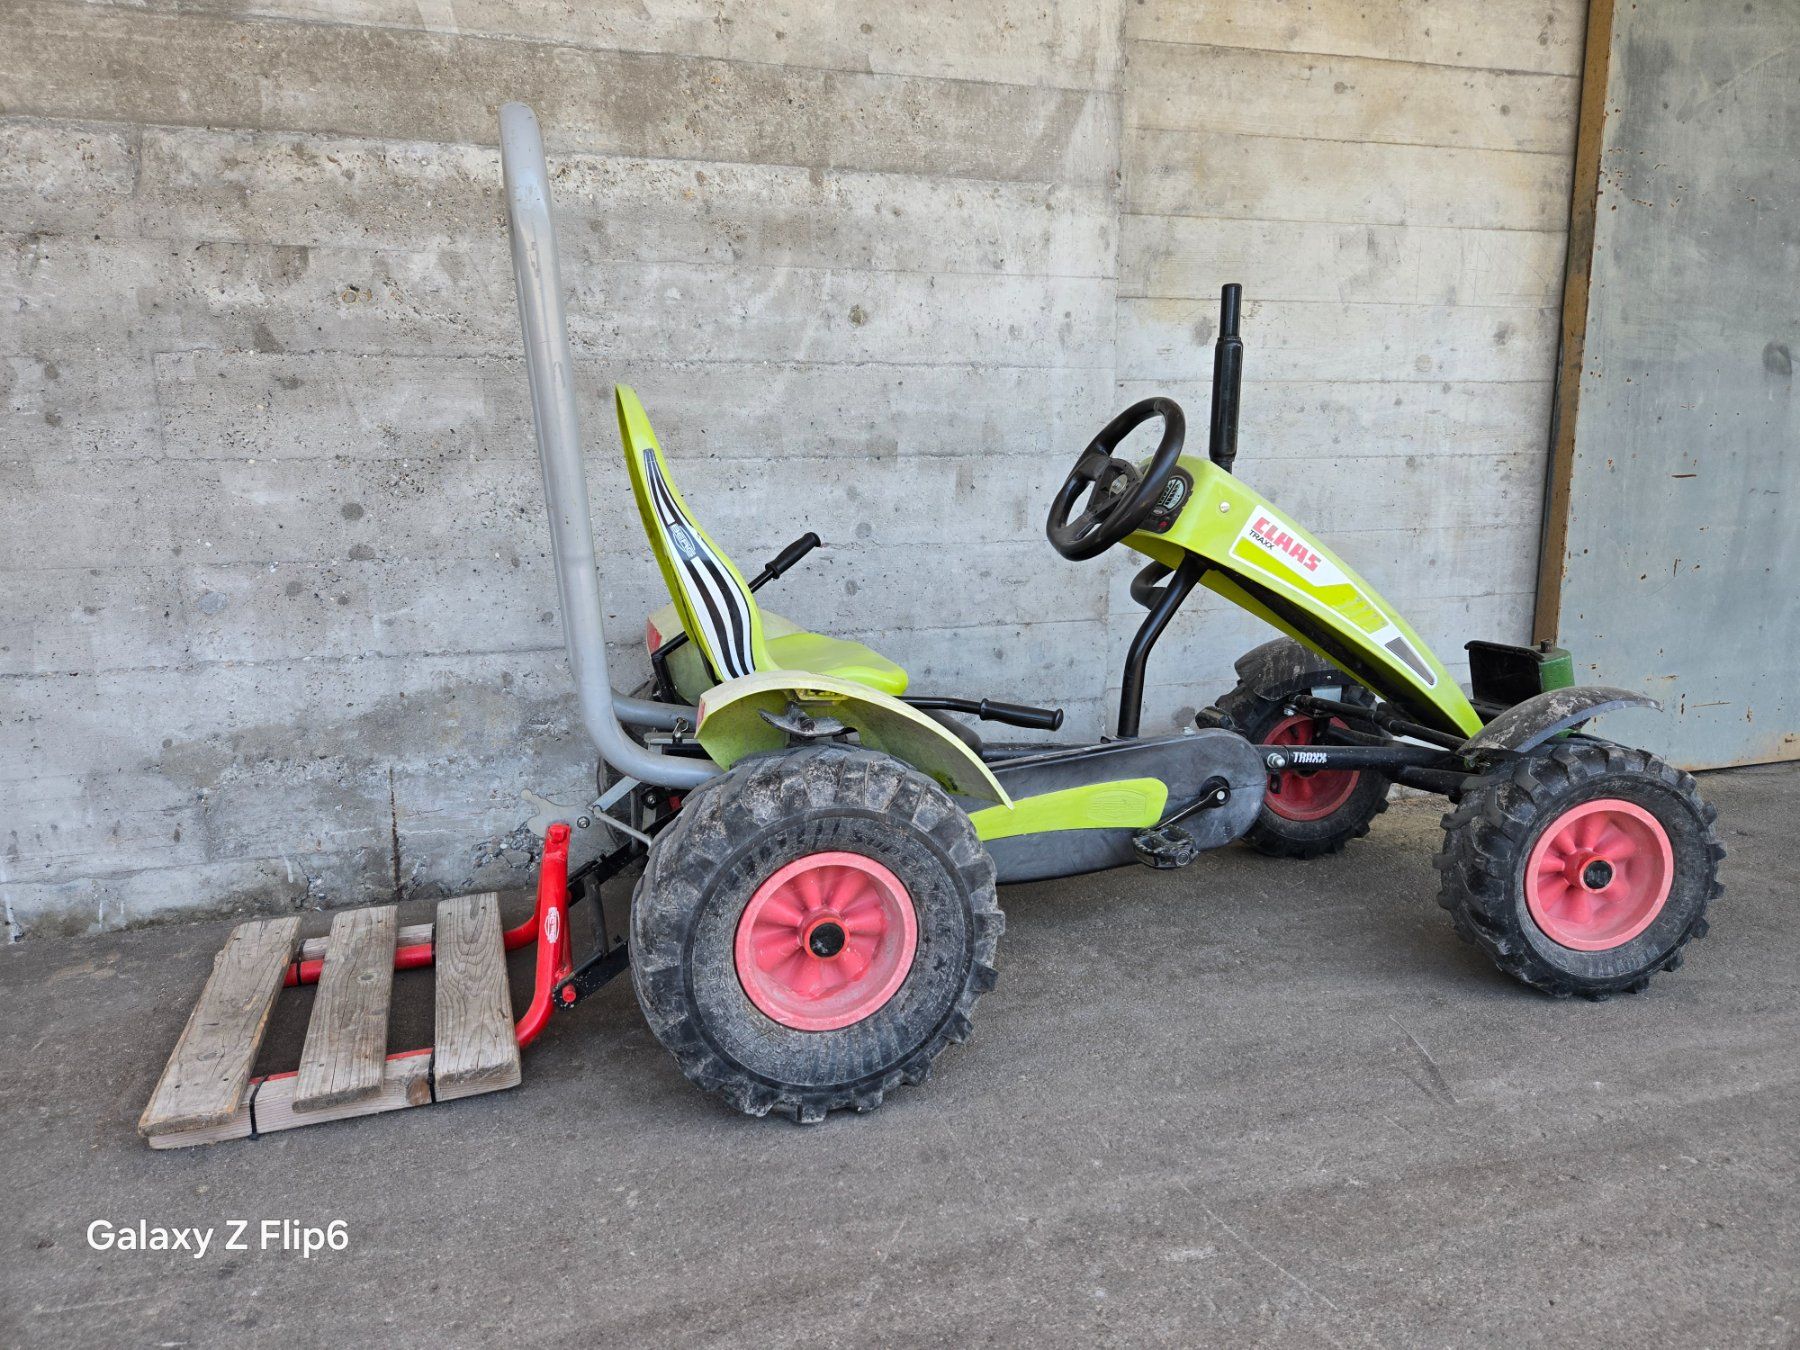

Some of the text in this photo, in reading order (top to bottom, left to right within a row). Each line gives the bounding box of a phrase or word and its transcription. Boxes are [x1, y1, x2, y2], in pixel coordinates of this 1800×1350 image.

[1249, 529, 1275, 551] TRAXX
[1252, 516, 1322, 572] CLAAS
[1292, 751, 1328, 764] TRAXX
